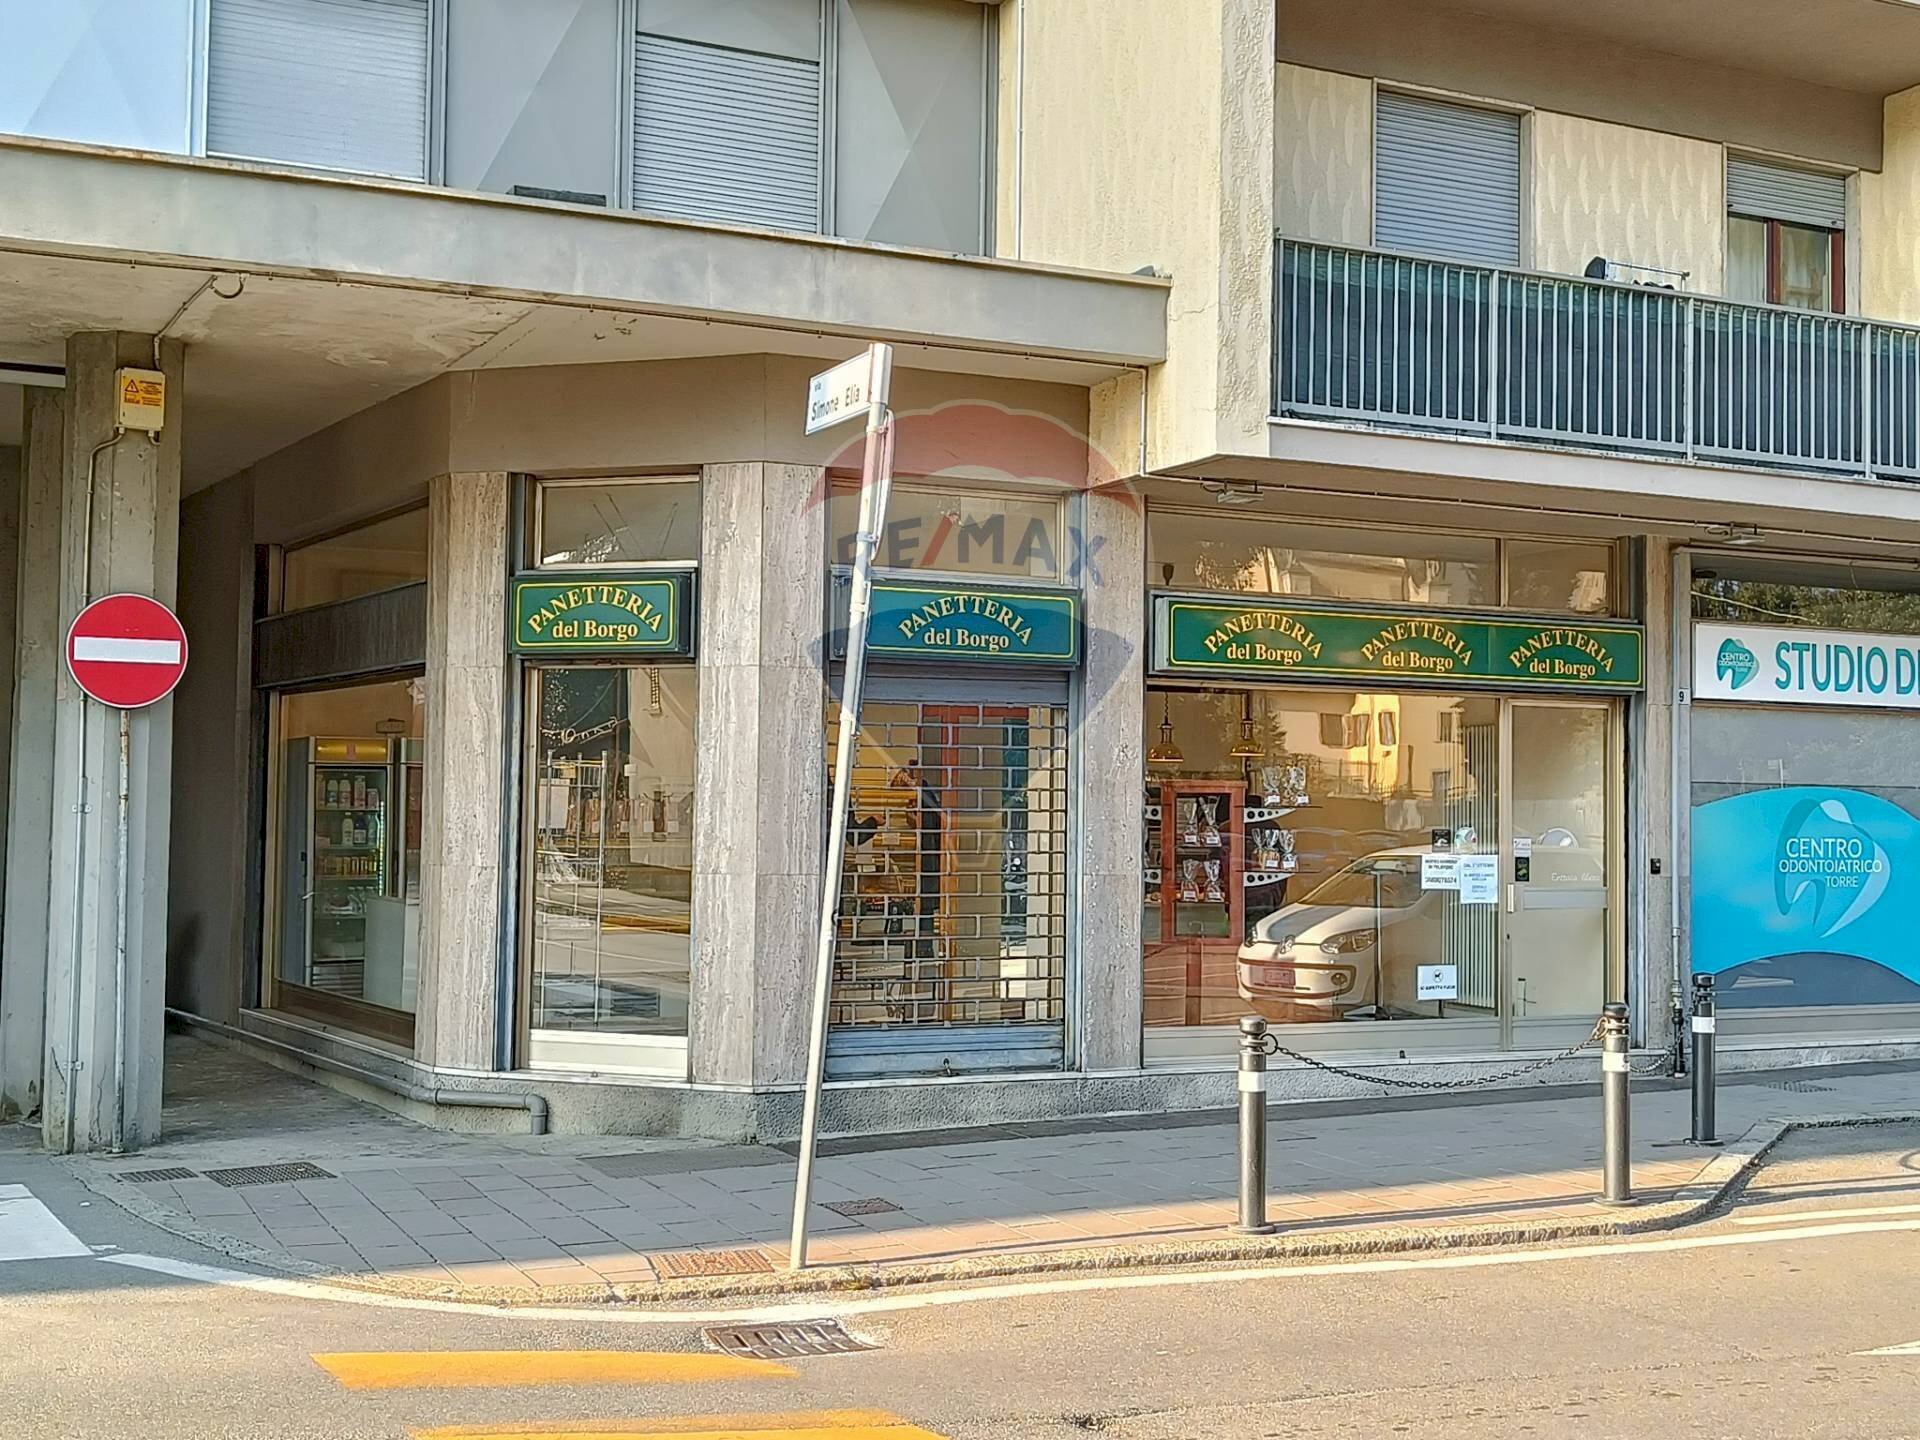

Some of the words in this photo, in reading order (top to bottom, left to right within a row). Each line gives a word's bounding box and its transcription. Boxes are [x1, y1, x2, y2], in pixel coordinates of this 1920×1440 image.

[811, 396, 839, 422] Simone
[845, 384, 860, 408] Elia
[527, 585, 663, 635] PANETTERIA
[897, 595, 1033, 647] PANETTERIA
[552, 619, 581, 639] del
[584, 620, 638, 642] Borgo
[923, 626, 953, 646] del
[956, 627, 1010, 650] Borgo
[1203, 612, 1323, 659] PANETTERIA
[1226, 641, 1252, 661] del
[1254, 643, 1302, 664] Borgo
[1360, 619, 1473, 667] PANETTERIA
[1508, 628, 1614, 674] PANETTERIA
[1382, 650, 1406, 668] del
[1409, 652, 1454, 672] Borgo
[1528, 657, 1552, 675] del
[1554, 659, 1596, 679] Borgo
[1721, 652, 1750, 662] CENTRO
[1775, 640, 1888, 695] STUDIO
[1895, 648, 1920, 696] D
[1786, 838, 1862, 858] CENTRO
[1778, 858, 1883, 873] ODONTOIATRICO
[1824, 875, 1859, 888] TORRE
